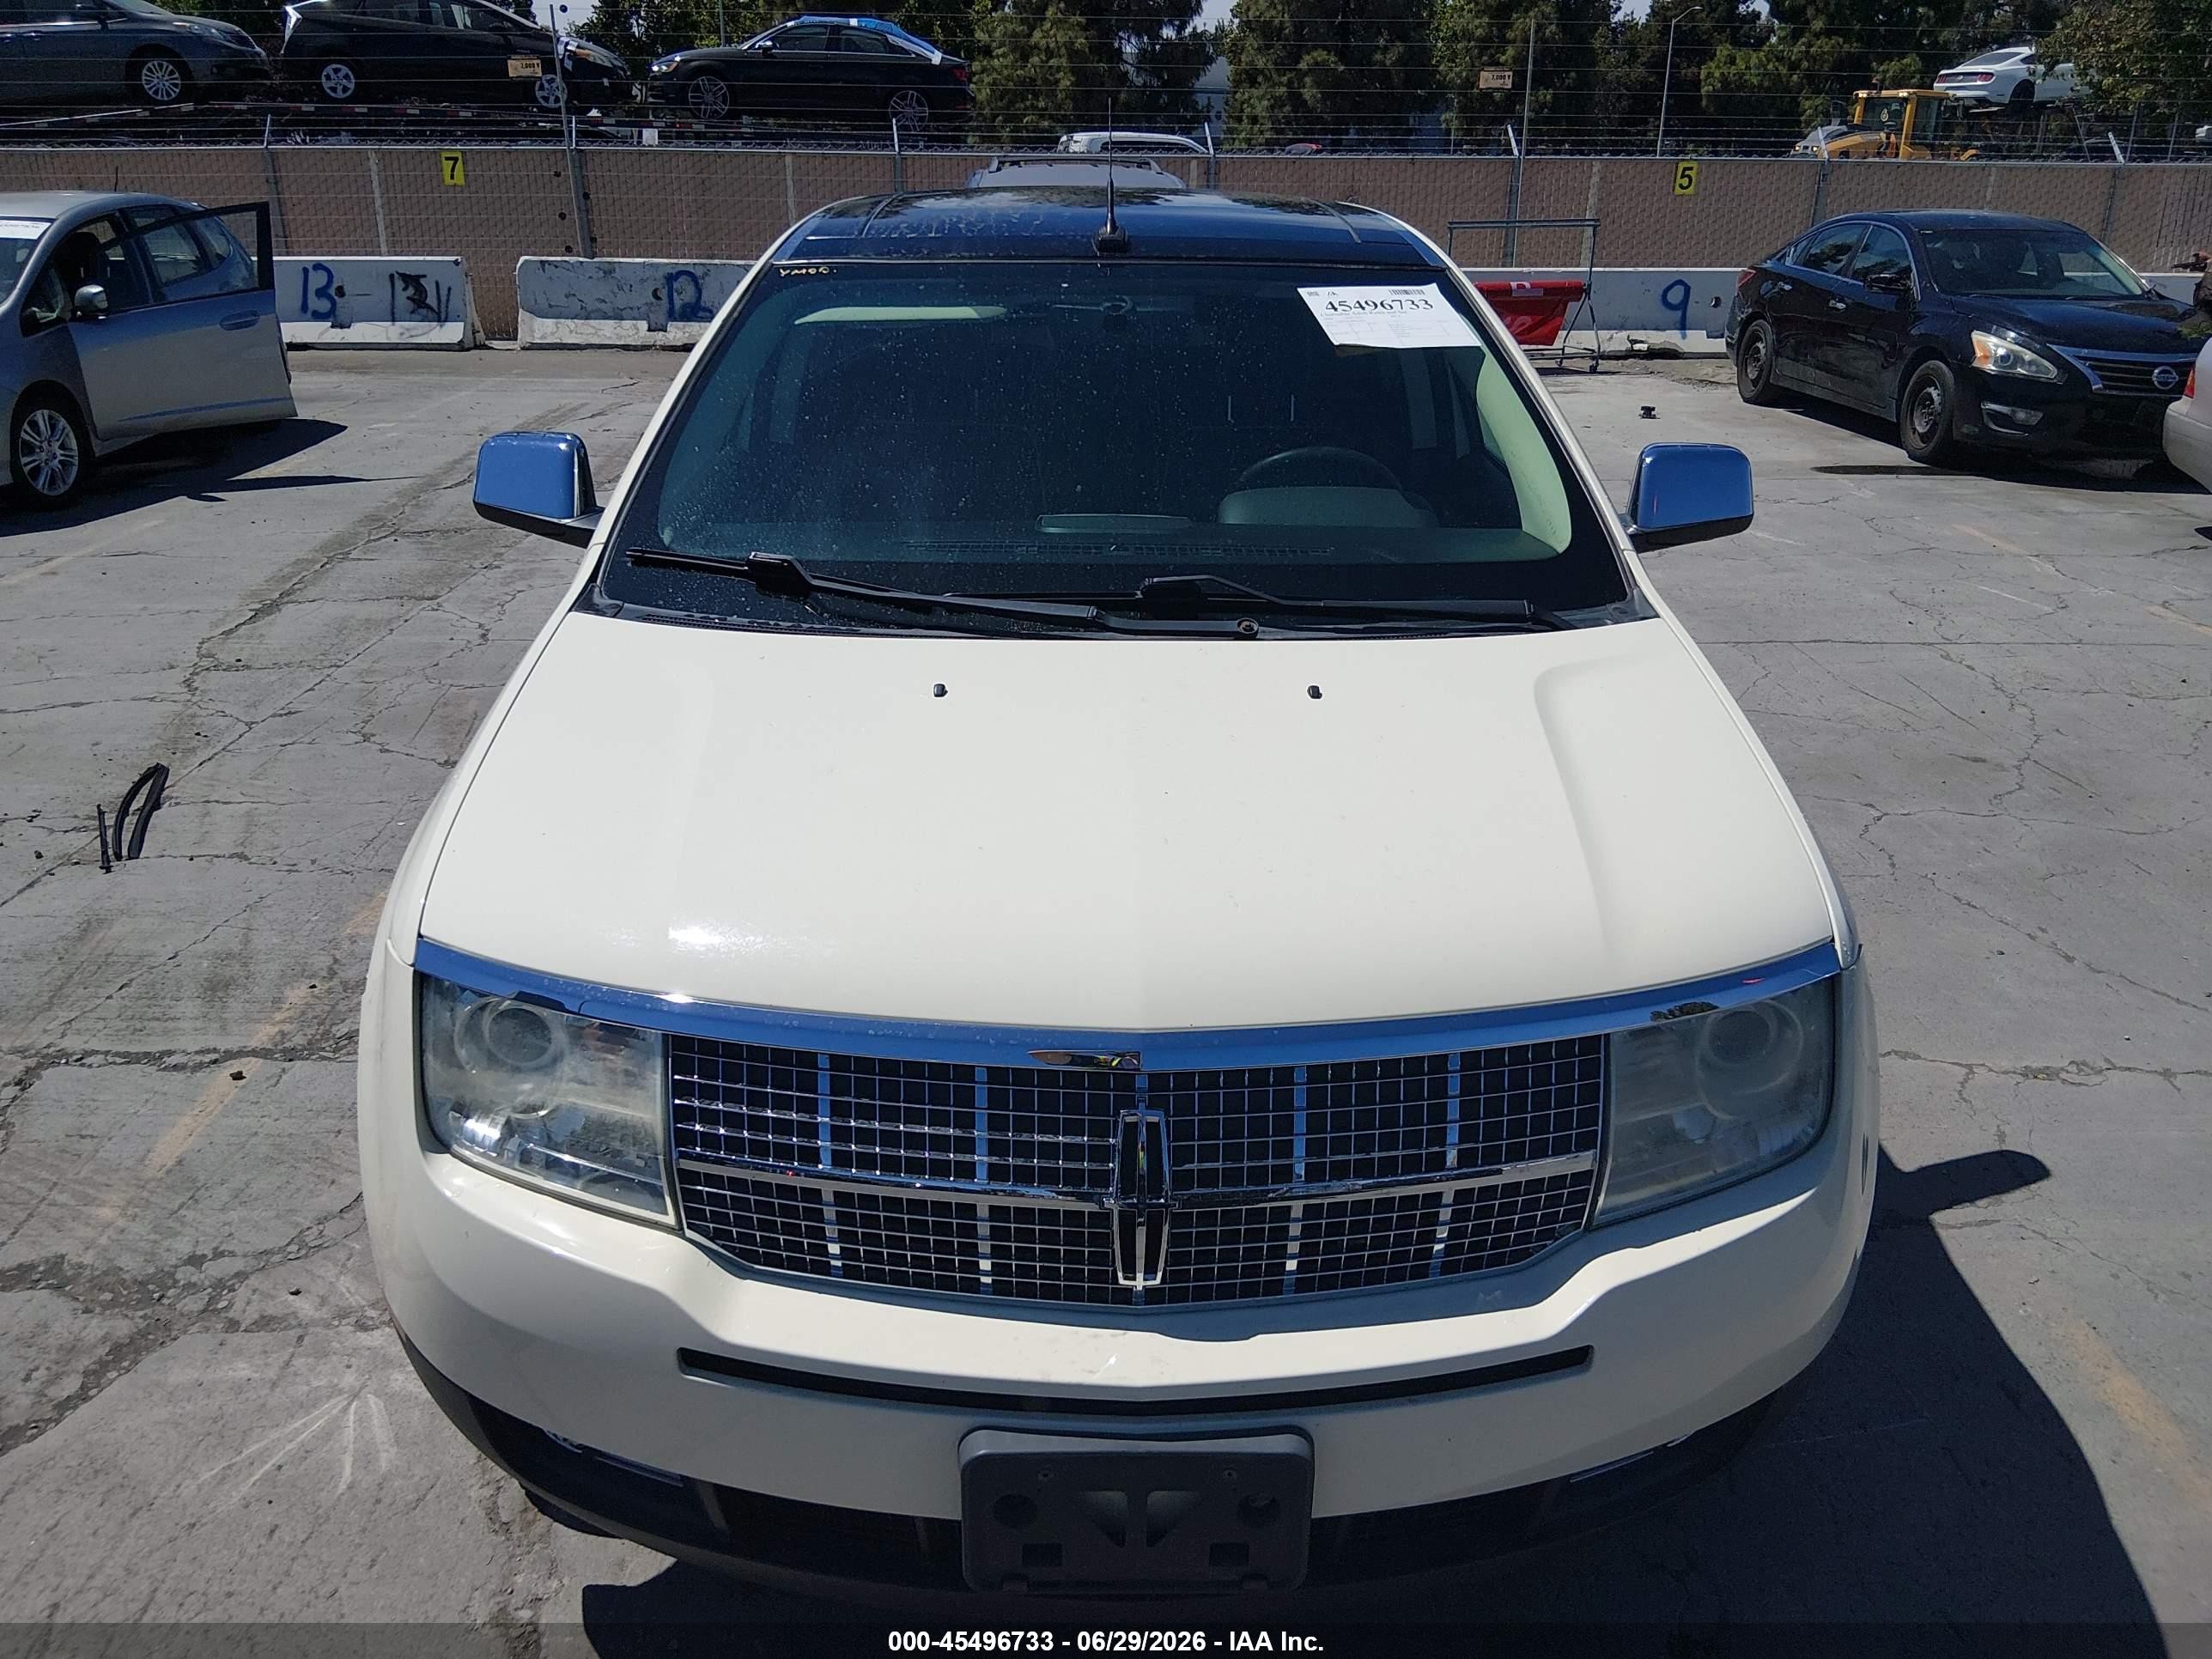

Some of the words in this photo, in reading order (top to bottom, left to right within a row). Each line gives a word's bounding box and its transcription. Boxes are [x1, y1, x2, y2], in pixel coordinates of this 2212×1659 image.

[444, 156, 459, 180] 7
[1678, 166, 1694, 191] 5
[301, 263, 337, 320] 13
[666, 270, 714, 319] 12
[1325, 298, 1434, 313] 45496733
[1661, 278, 1692, 340] 9
